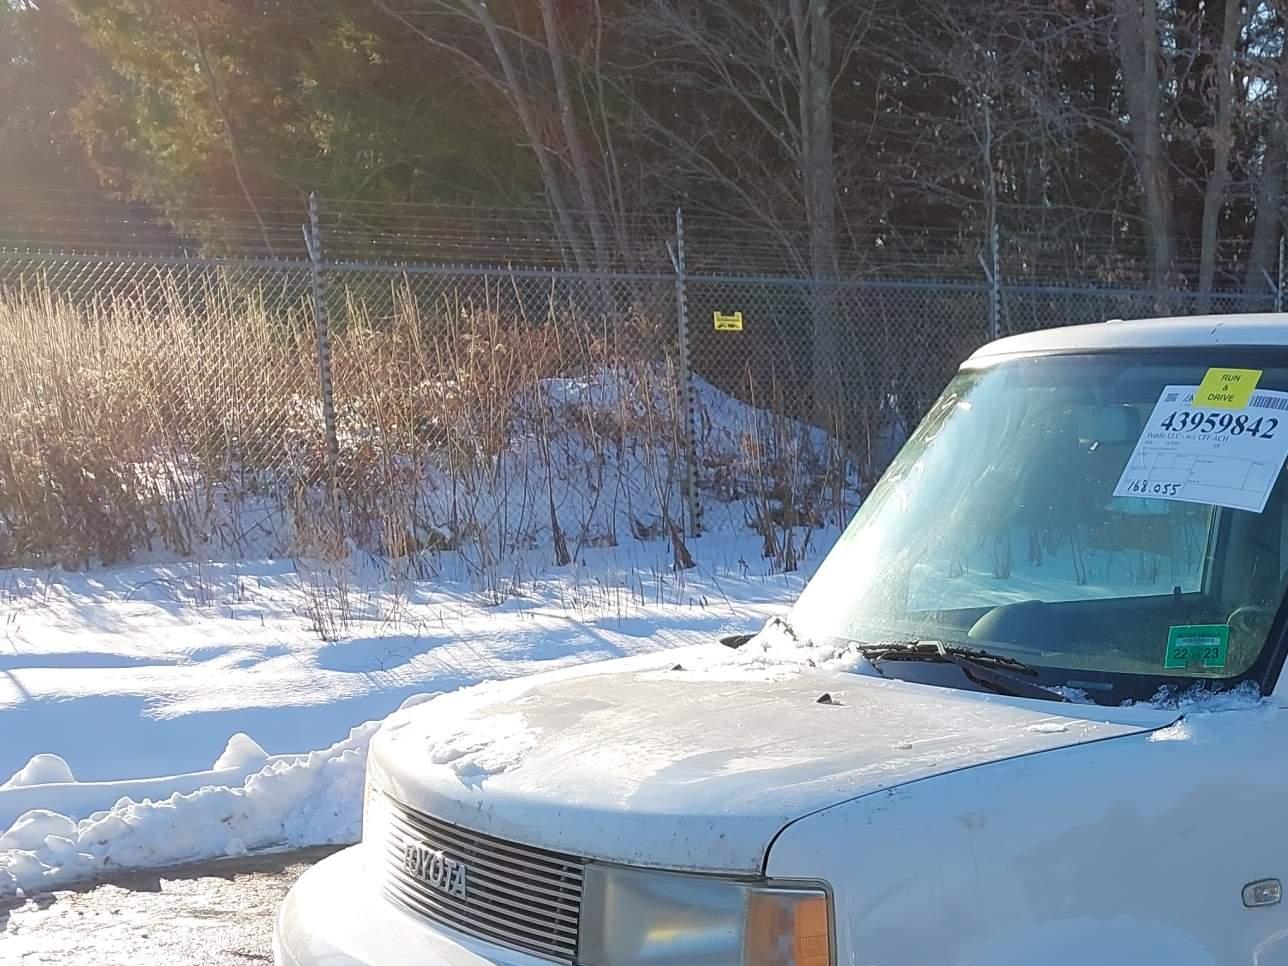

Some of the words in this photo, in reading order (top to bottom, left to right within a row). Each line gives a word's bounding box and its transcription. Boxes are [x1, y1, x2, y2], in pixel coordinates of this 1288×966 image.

[1220, 374, 1242, 382] RUN
[1207, 393, 1235, 402] DRIVE
[1160, 410, 1279, 439] 43959842
[1173, 648, 1188, 659] 22
[1203, 647, 1219, 658] 23
[403, 844, 467, 900] TOYOTA
